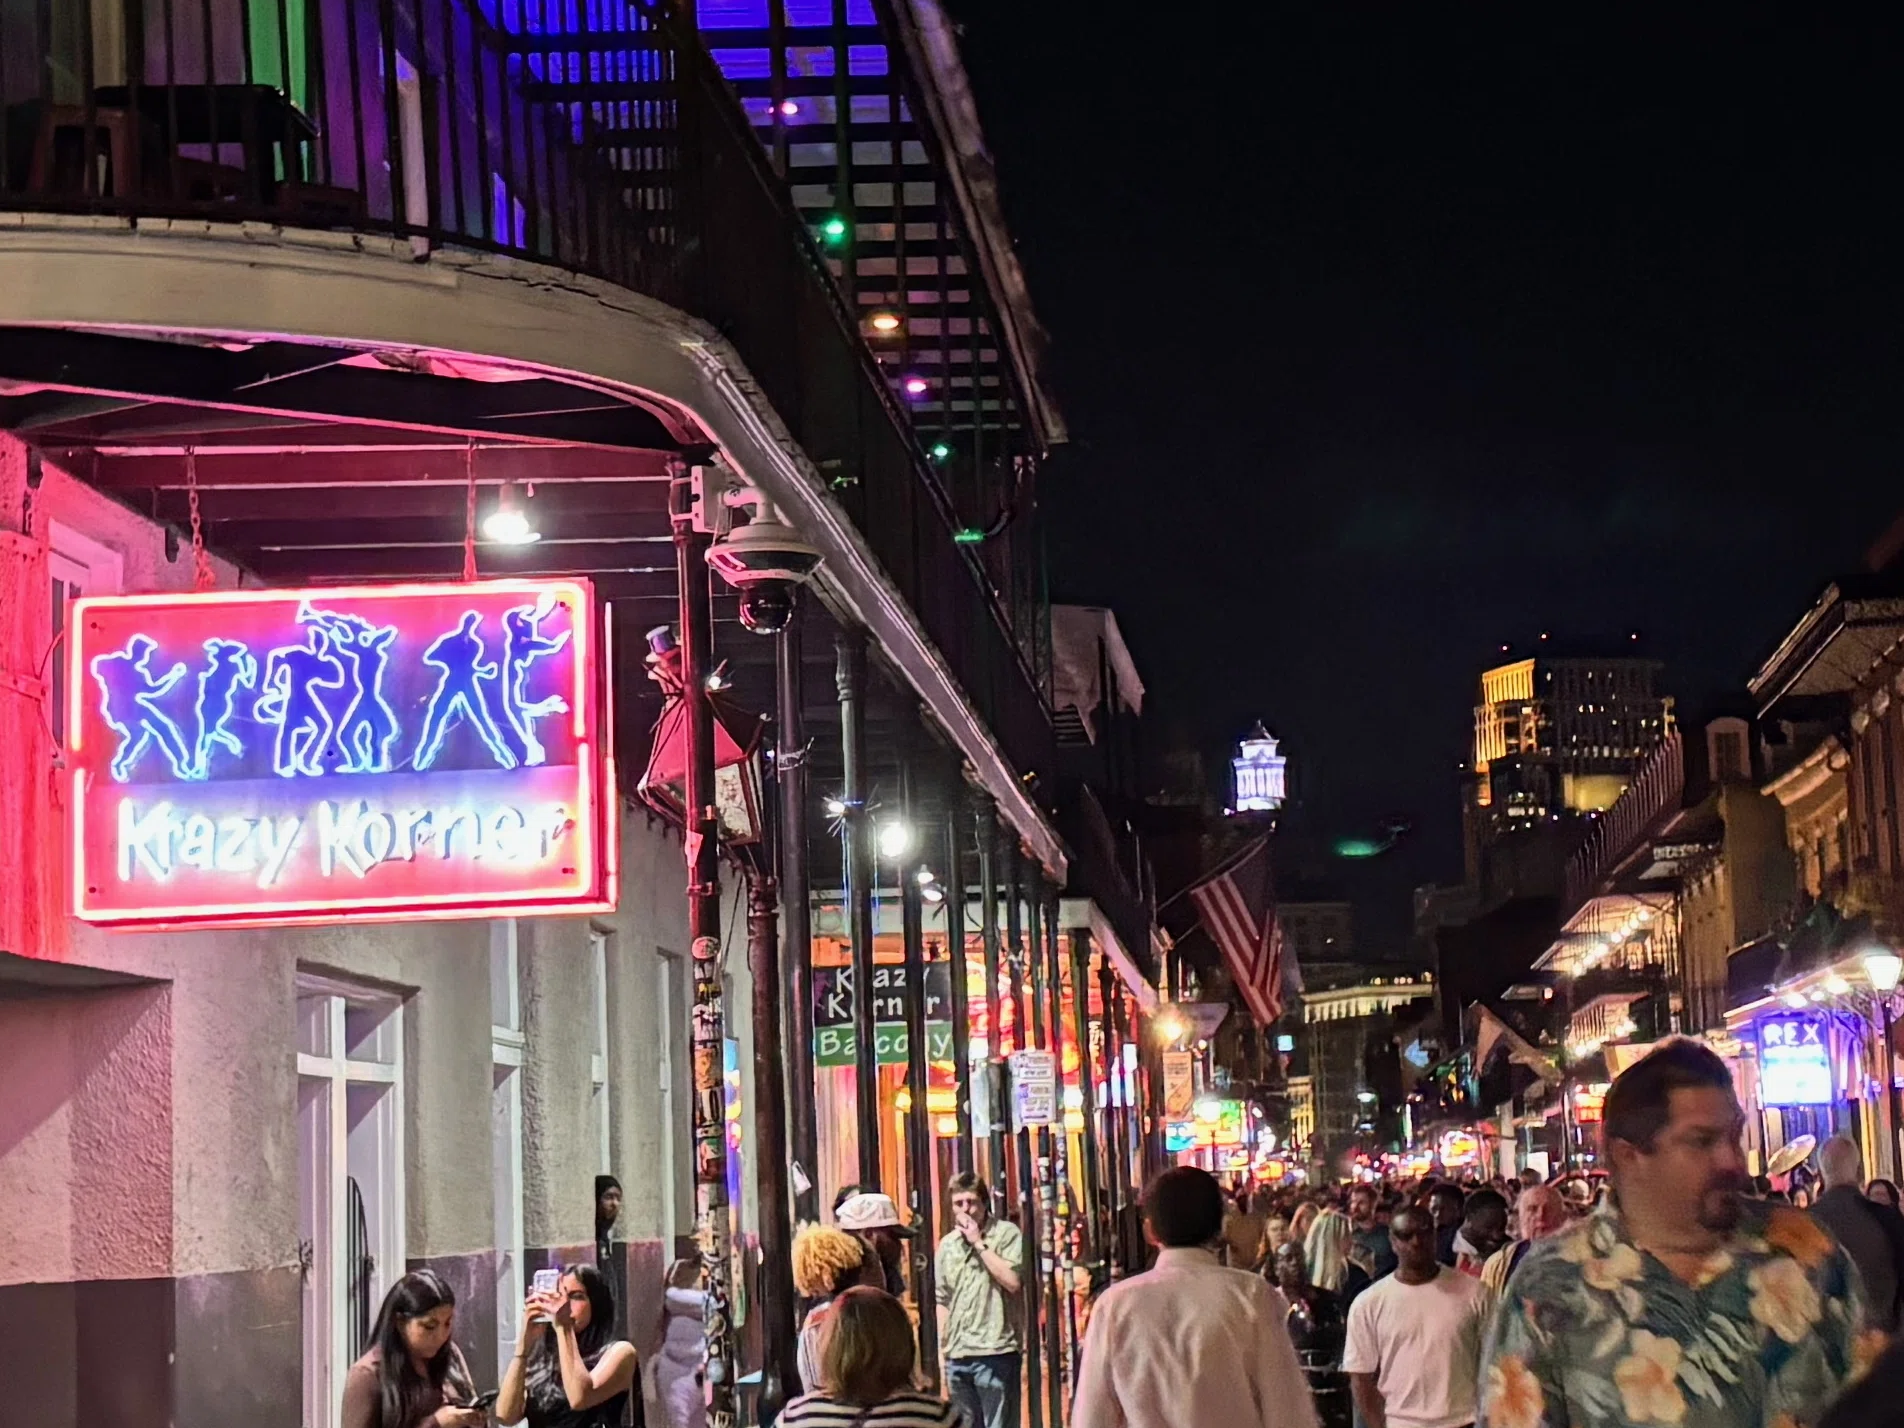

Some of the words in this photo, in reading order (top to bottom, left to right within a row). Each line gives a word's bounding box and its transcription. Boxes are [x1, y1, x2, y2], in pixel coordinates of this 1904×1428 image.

[116, 796, 302, 890] Krazy
[318, 798, 568, 880] Korner
[836, 966, 930, 993] Kaz
[828, 993, 941, 1019] Krnr
[820, 1029, 952, 1059] Bacoy
[1763, 1021, 1820, 1046] REX
